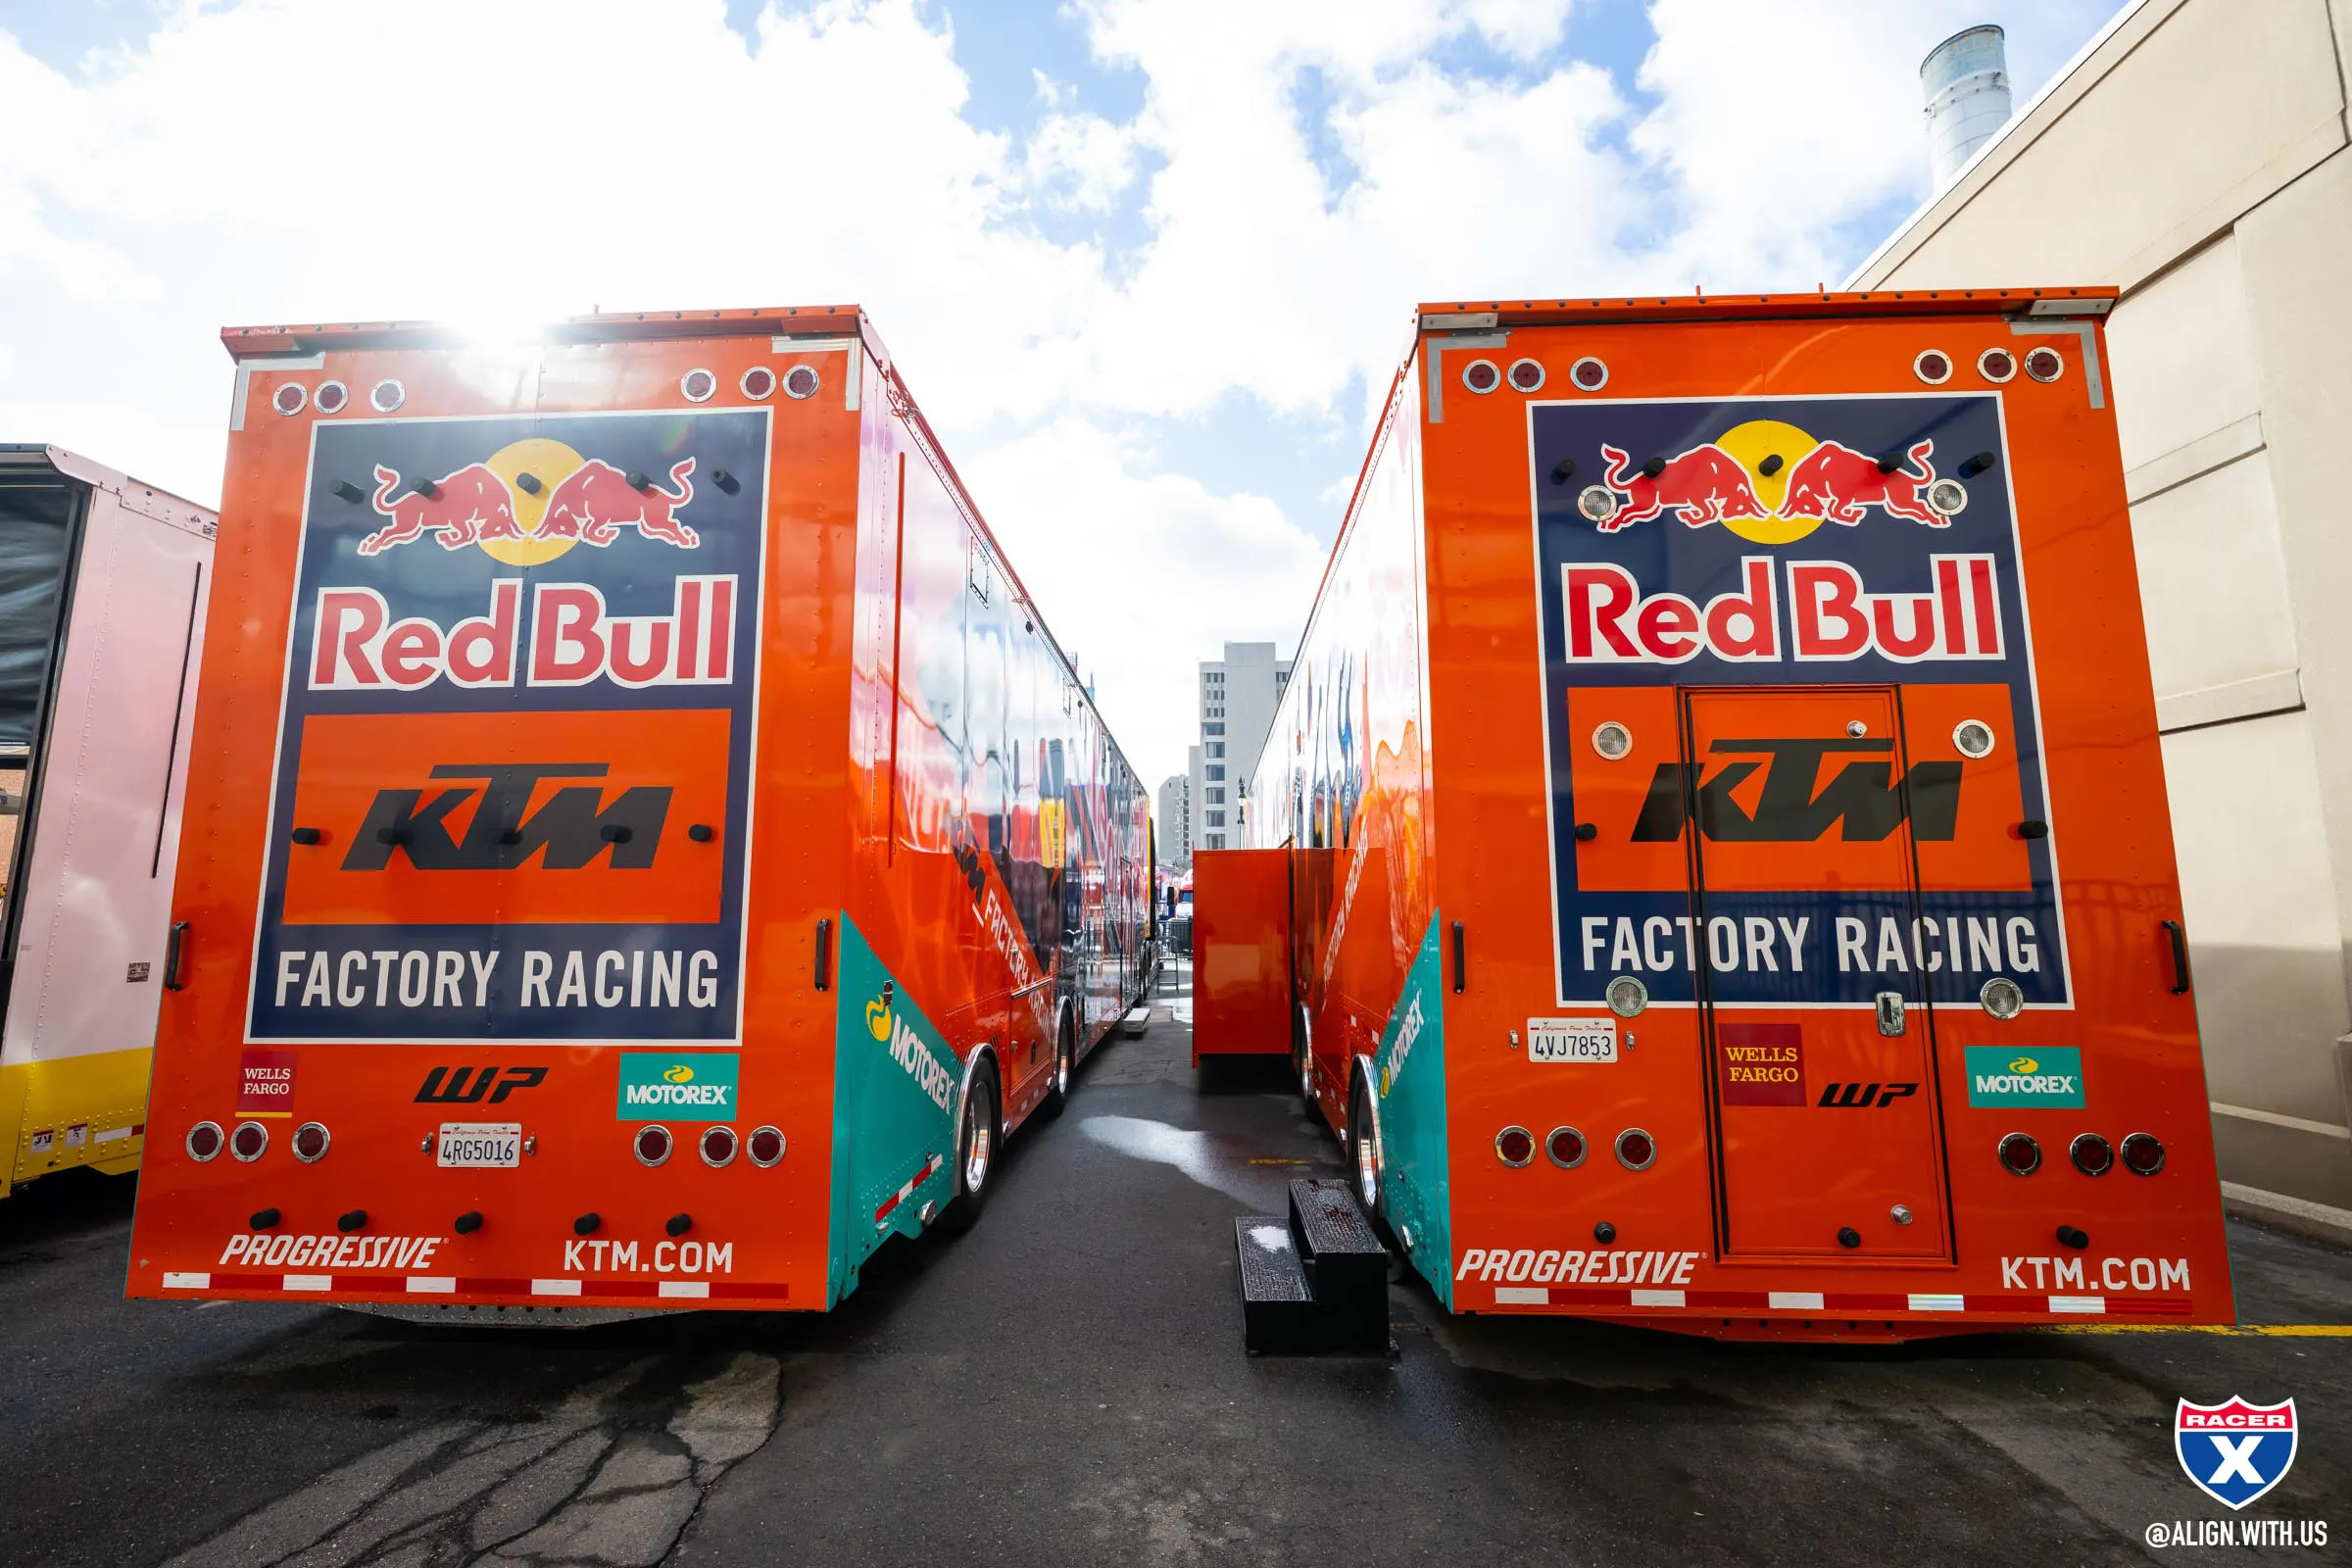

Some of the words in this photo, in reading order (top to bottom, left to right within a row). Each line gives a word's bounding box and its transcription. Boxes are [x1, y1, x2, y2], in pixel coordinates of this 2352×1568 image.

[1561, 556, 1782, 663] Red
[1787, 554, 2006, 663] Bull
[308, 578, 523, 691] Red
[526, 574, 739, 689] Bull
[1630, 738, 1963, 842] KTM
[340, 762, 673, 870] KTM
[984, 888, 1030, 991] FACTORY
[1581, 916, 1810, 972] FACTORY
[1836, 916, 2040, 972] RACING
[274, 950, 500, 1008] FACTORY
[520, 950, 718, 1008] RACING
[1535, 1036, 1611, 1055] 4VJ7853
[1725, 1047, 1798, 1062] WELLS
[244, 1067, 291, 1081] WELLS
[889, 1013, 955, 1115] MOTOREX
[1729, 1066, 1799, 1083] FARGO
[243, 1082, 289, 1096] FARGO
[414, 1066, 550, 1103] WP
[626, 1084, 728, 1105] MOTOREX
[1817, 1082, 1920, 1108] WP
[1976, 1075, 2074, 1095] MOTOREX
[442, 1140, 515, 1160] 4RG5016
[220, 1235, 443, 1268] PROGRESSIVE
[564, 1241, 733, 1273] KTM.COM
[1455, 1250, 1699, 1285] PROGRESSIVE
[2001, 1257, 2191, 1292] KTM.COM
